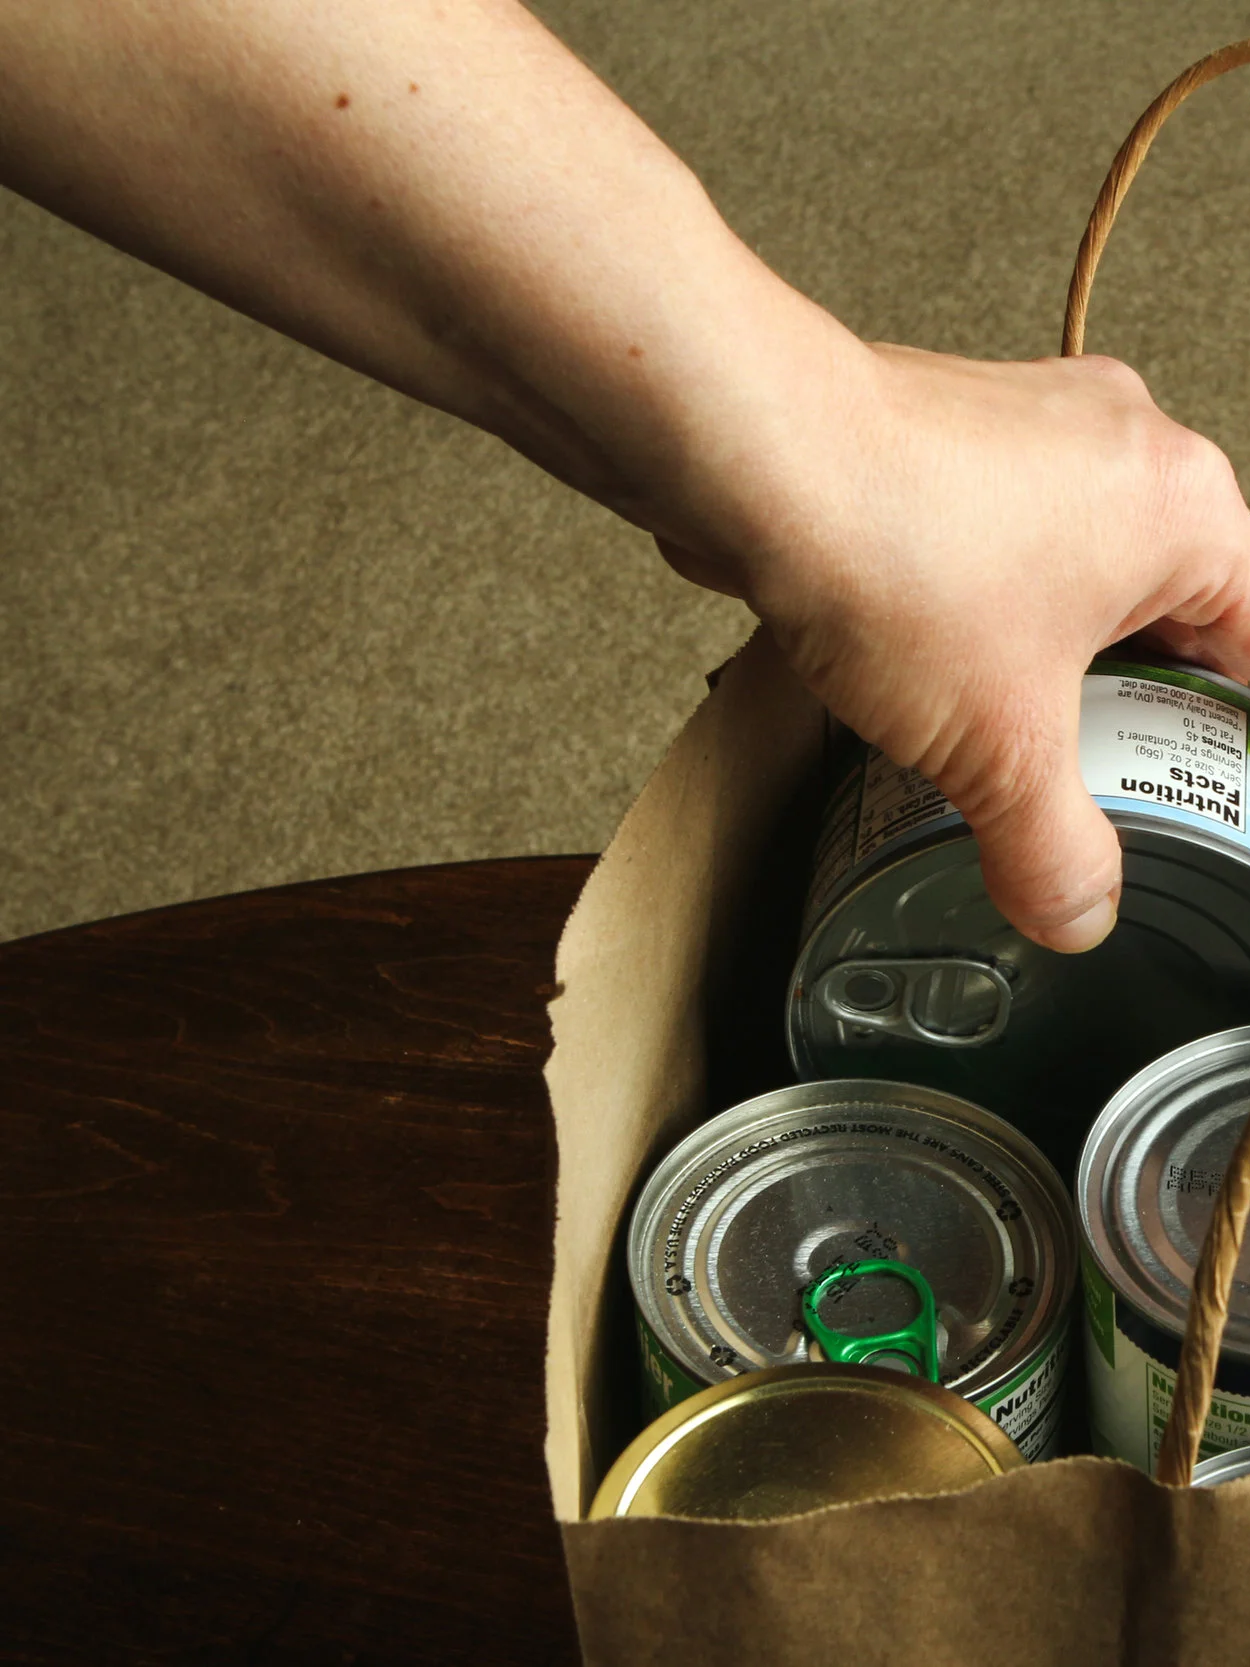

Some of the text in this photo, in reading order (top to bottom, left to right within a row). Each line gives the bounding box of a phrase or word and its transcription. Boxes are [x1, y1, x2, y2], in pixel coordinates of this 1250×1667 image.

[1119, 680, 1137, 690] diet.
[1141, 682, 1168, 696] calorie
[1118, 690, 1131, 698] are
[1135, 692, 1154, 703] (DV)
[1171, 689, 1194, 703] 2,000
[1157, 696, 1184, 711] Values
[1186, 703, 1206, 718] Daily
[1204, 699, 1213, 707] on
[1216, 703, 1239, 719] based
[1183, 718, 1234, 743] Fat Cal. 10
[1118, 731, 1242, 773] Servings Per Container 5
[1186, 731, 1242, 759] Calories 45
[1135, 745, 1241, 786] Serv. Size 2 oz. (56g)
[1169, 767, 1240, 805] Facts
[1121, 778, 1240, 827] Nutrition
[780, 1124, 847, 1142] RECYCLED
[851, 1124, 891, 1136] MOST
[897, 1129, 919, 1142] THE
[923, 1135, 948, 1151] ARE
[949, 1148, 983, 1172] CANS
[664, 1240, 679, 1272] U.S.A.
[960, 1309, 1023, 1372] RECYCLABLE
[1228, 1425, 1247, 1437] 1/2
